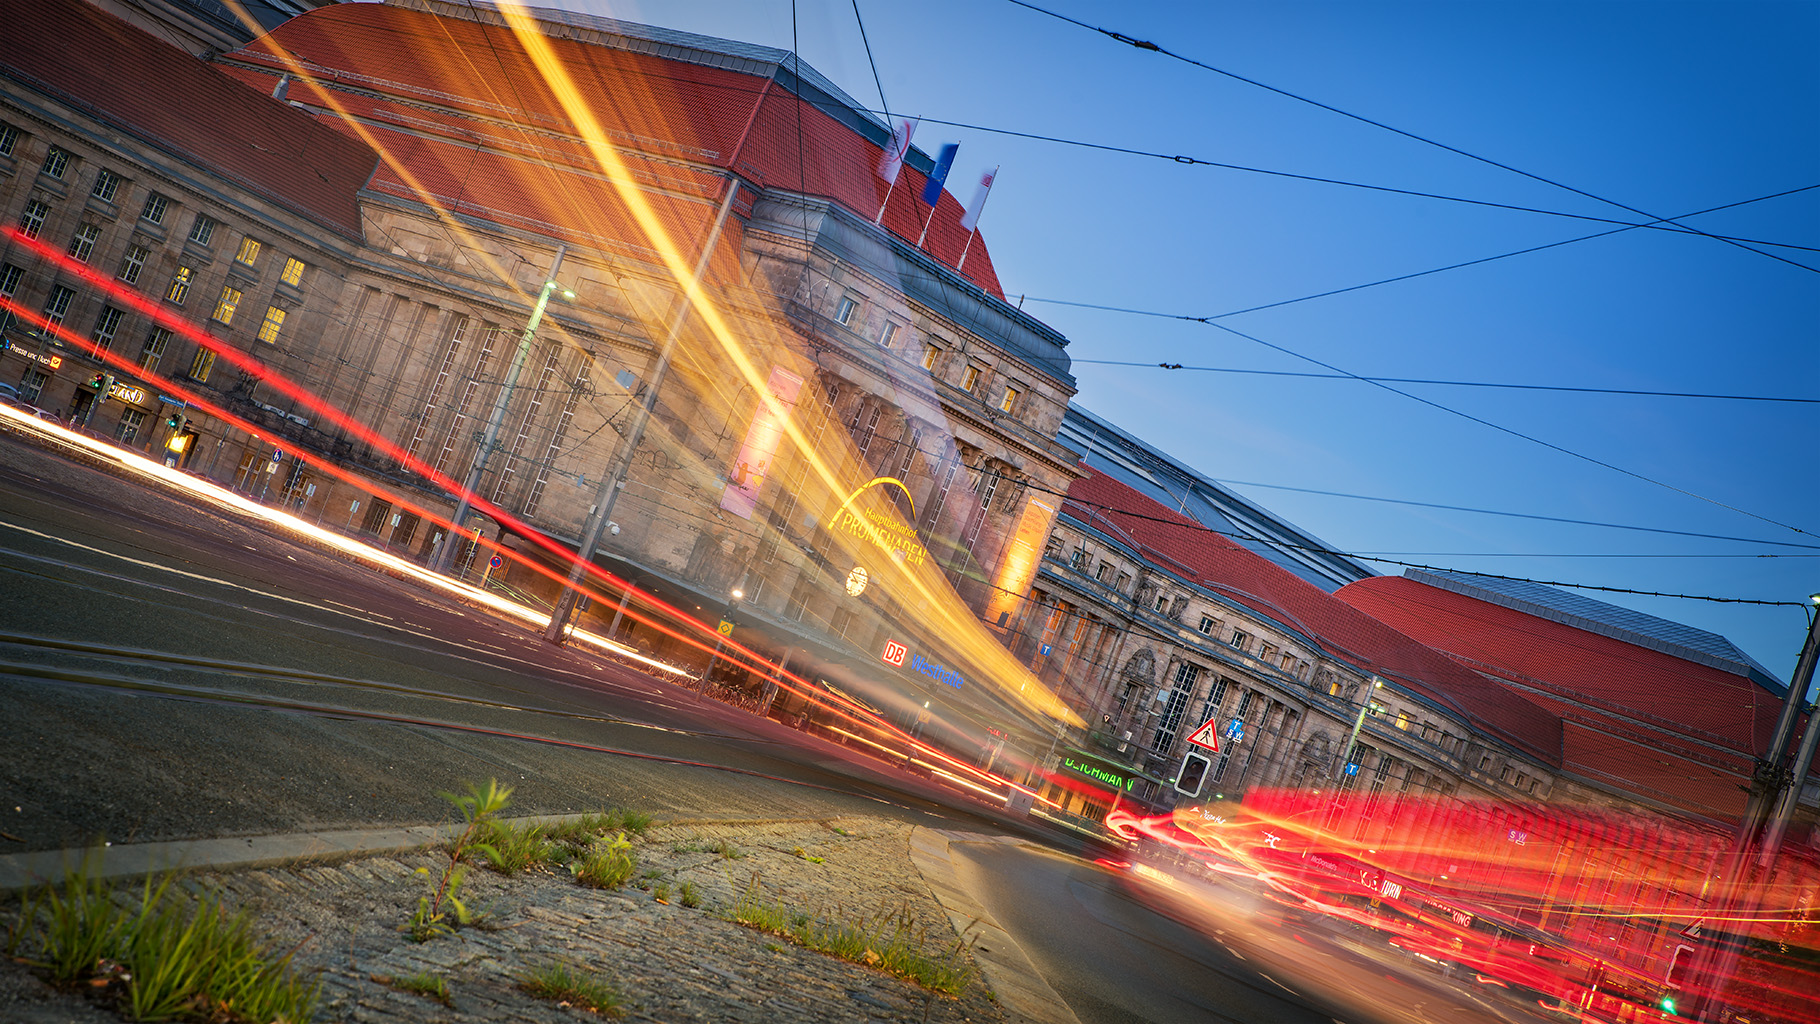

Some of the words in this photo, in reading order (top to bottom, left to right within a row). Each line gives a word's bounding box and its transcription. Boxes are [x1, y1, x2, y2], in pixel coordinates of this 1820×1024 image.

[10, 343, 28, 357] Presse
[864, 506, 917, 539] Hauptbahnhof
[885, 642, 905, 665] DB
[911, 653, 964, 690] Westhalle
